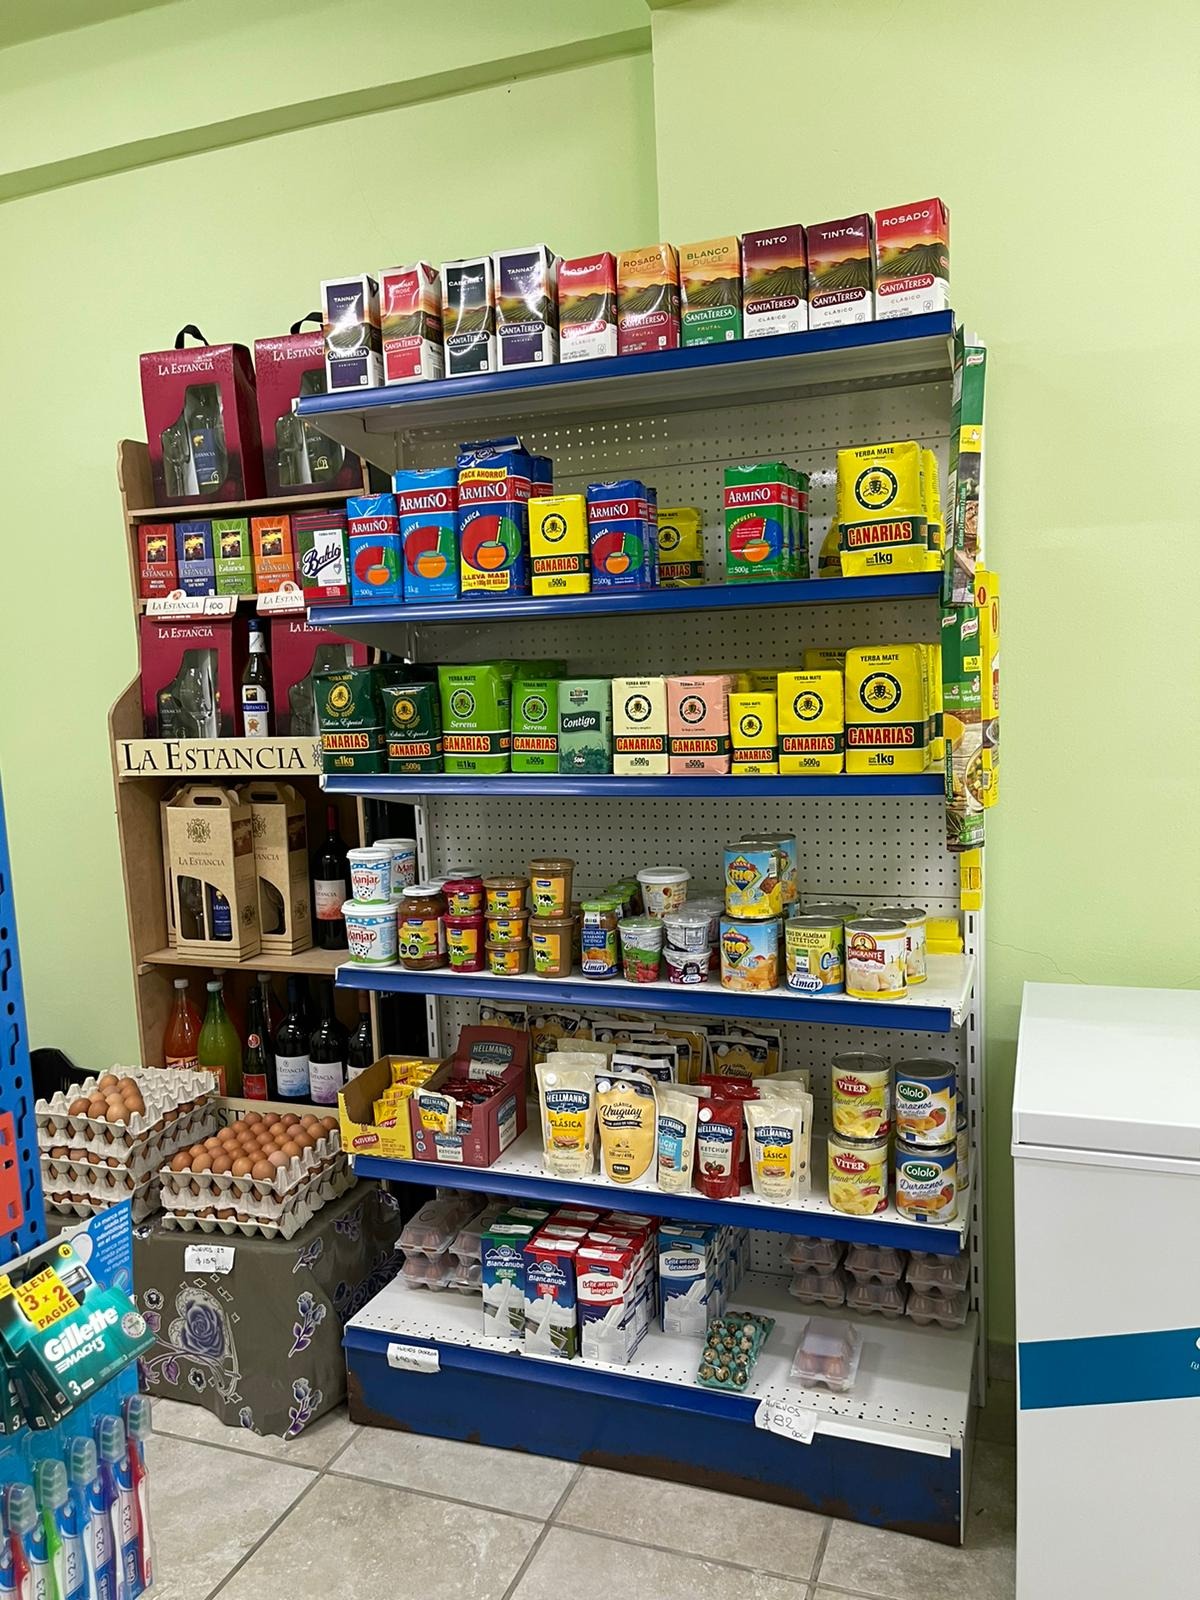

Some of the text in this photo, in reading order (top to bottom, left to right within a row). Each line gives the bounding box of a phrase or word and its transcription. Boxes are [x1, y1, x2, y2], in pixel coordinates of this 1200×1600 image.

[882, 210, 930, 227] ROSADO
[821, 227, 854, 239] TINTO
[755, 235, 788, 247] TINTO
[623, 253, 662, 268] ROSADO
[687, 256, 730, 270] BLANCO
[273, 350, 286, 362] LA
[158, 361, 215, 376] LA ESTANCIA
[855, 447, 895, 458] YERBA MATE
[459, 481, 508, 500] ARMIÑO
[728, 487, 771, 504] ARMIÑO
[399, 491, 448, 511] ARMIÑO
[590, 505, 629, 520] ARMIÑO
[351, 519, 388, 535] ARMIÑO
[848, 521, 913, 547] CANARIAS
[303, 542, 342, 577] Baldo
[534, 556, 579, 574] CANARIAS
[873, 553, 893, 572] 1kg
[659, 564, 690, 578] NARIAS
[152, 600, 200, 611] LA ESTANCIA
[158, 625, 214, 639] LA ESTANCIA
[290, 622, 302, 633] LA
[860, 653, 899, 663] YERBA MATE
[450, 720, 478, 729] Serena
[523, 723, 547, 733] Serena
[562, 715, 596, 729] Contigo
[322, 733, 370, 751] CANARIAS
[442, 735, 491, 751] CANARIAS
[513, 736, 557, 751] CANARIAS
[848, 726, 914, 746] CANARIAS
[389, 742, 432, 757] CANARIAS
[616, 736, 663, 752] CANARIAS
[672, 739, 718, 754] CANARIAS
[783, 736, 835, 752] CANARIAS
[121, 740, 308, 774] LA ESTANCIA
[634, 757, 650, 768] 500g
[733, 750, 773, 762] CANARIAS
[803, 757, 820, 768] 500g
[874, 753, 894, 766] 1kg
[689, 759, 705, 770] 500g
[178, 856, 226, 868] LA ESTANCIA
[584, 960, 607, 974] Limay
[789, 973, 821, 990] Limay
[472, 1043, 513, 1058] HELLMANN'S
[837, 1080, 868, 1094] VITER
[546, 1091, 588, 1106] HELLMANN'S
[600, 1104, 643, 1121] Uruguay
[550, 1118, 583, 1130] CLÁSICA
[701, 1145, 729, 1155] KETCHUP
[763, 1149, 788, 1160] LÁSICA
[834, 1157, 865, 1171] VITER
[900, 1177, 944, 1191] Duraznos
[485, 1260, 525, 1270] Blancanube
[16, 1268, 54, 1298] LLEVE
[528, 1275, 567, 1287] Blancanube
[24, 1294, 40, 1311] 3
[52, 1285, 69, 1303] 2
[37, 1298, 75, 1329] PAGUE
[43, 1305, 119, 1362] Gillette
[62, 1333, 106, 1370] MACH3
[68, 1380, 82, 1396] 3
